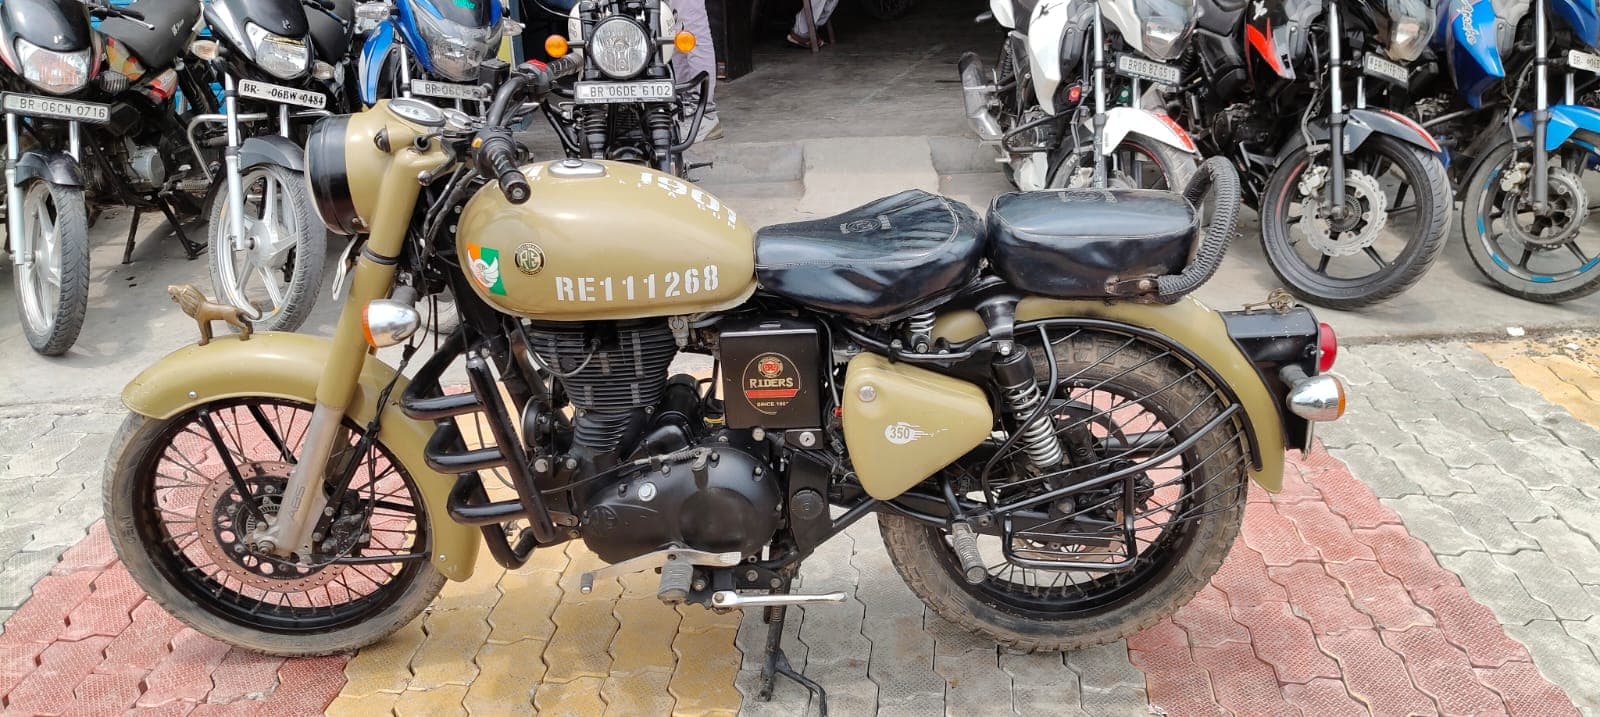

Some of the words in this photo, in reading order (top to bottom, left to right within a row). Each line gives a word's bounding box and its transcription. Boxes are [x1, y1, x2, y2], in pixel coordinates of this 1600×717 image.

[590, 86, 604, 97] BR
[609, 85, 637, 97] 06DE
[642, 85, 670, 97] 6102
[20, 98, 35, 110] BR
[41, 101, 72, 115] 06CN
[76, 106, 106, 119] 0716
[555, 264, 719, 302] RE111268
[749, 377, 794, 389] RIDERS
[889, 426, 911, 440] 350
